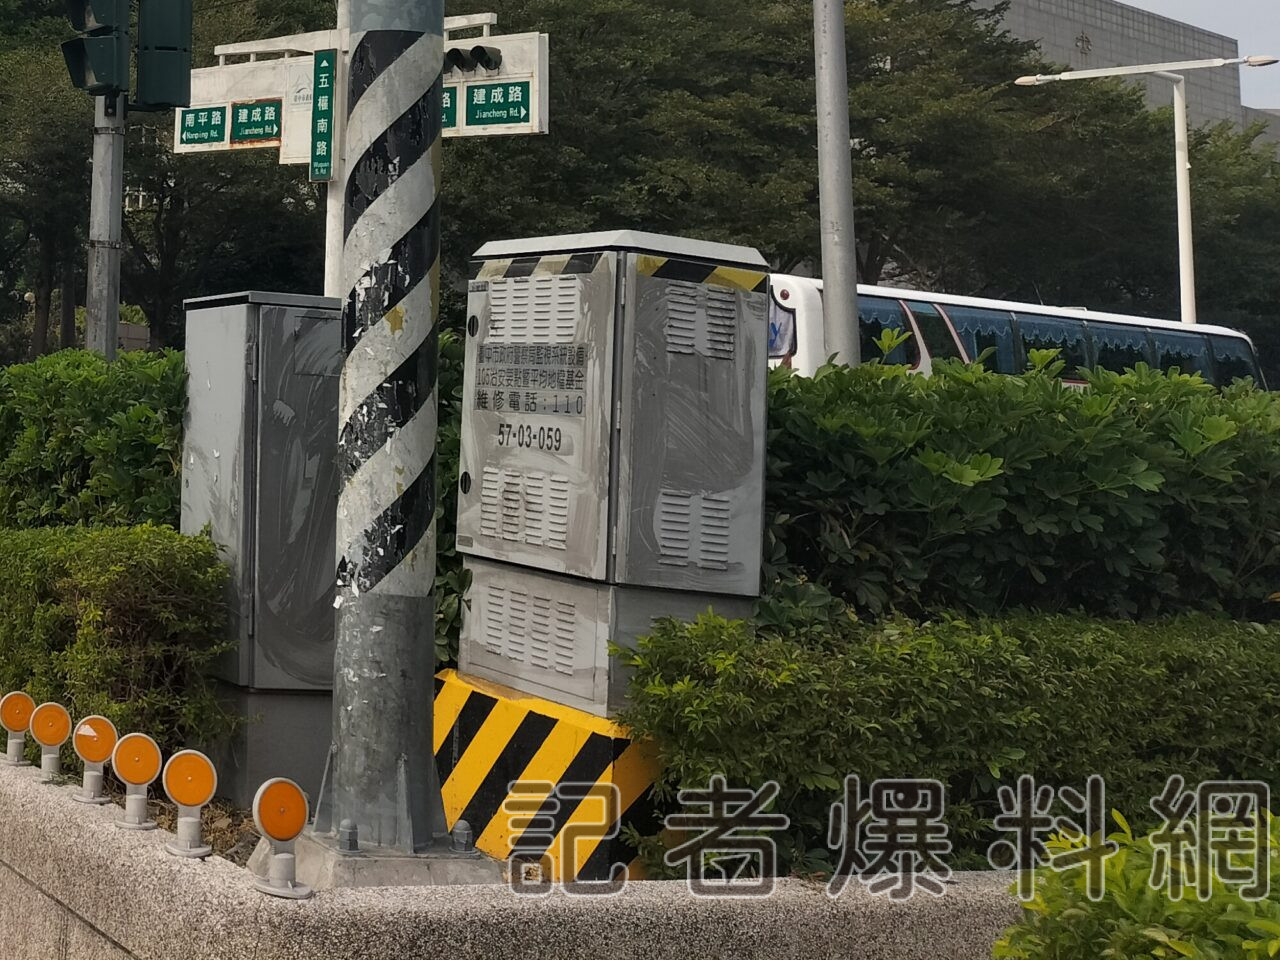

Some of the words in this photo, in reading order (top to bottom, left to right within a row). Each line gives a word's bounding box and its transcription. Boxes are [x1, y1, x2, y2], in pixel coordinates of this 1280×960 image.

[472, 86, 522, 105] 建成路
[185, 110, 222, 128] 南平路
[238, 106, 276, 123] 建成路
[315, 73, 330, 156] 五權南路
[475, 108, 508, 119] Jiancheng
[509, 107, 519, 117] Rd.
[186, 131, 209, 140] Nanping
[210, 129, 219, 138] Rd.
[239, 126, 264, 136] Jiancheng
[264, 125, 273, 134] Rd.
